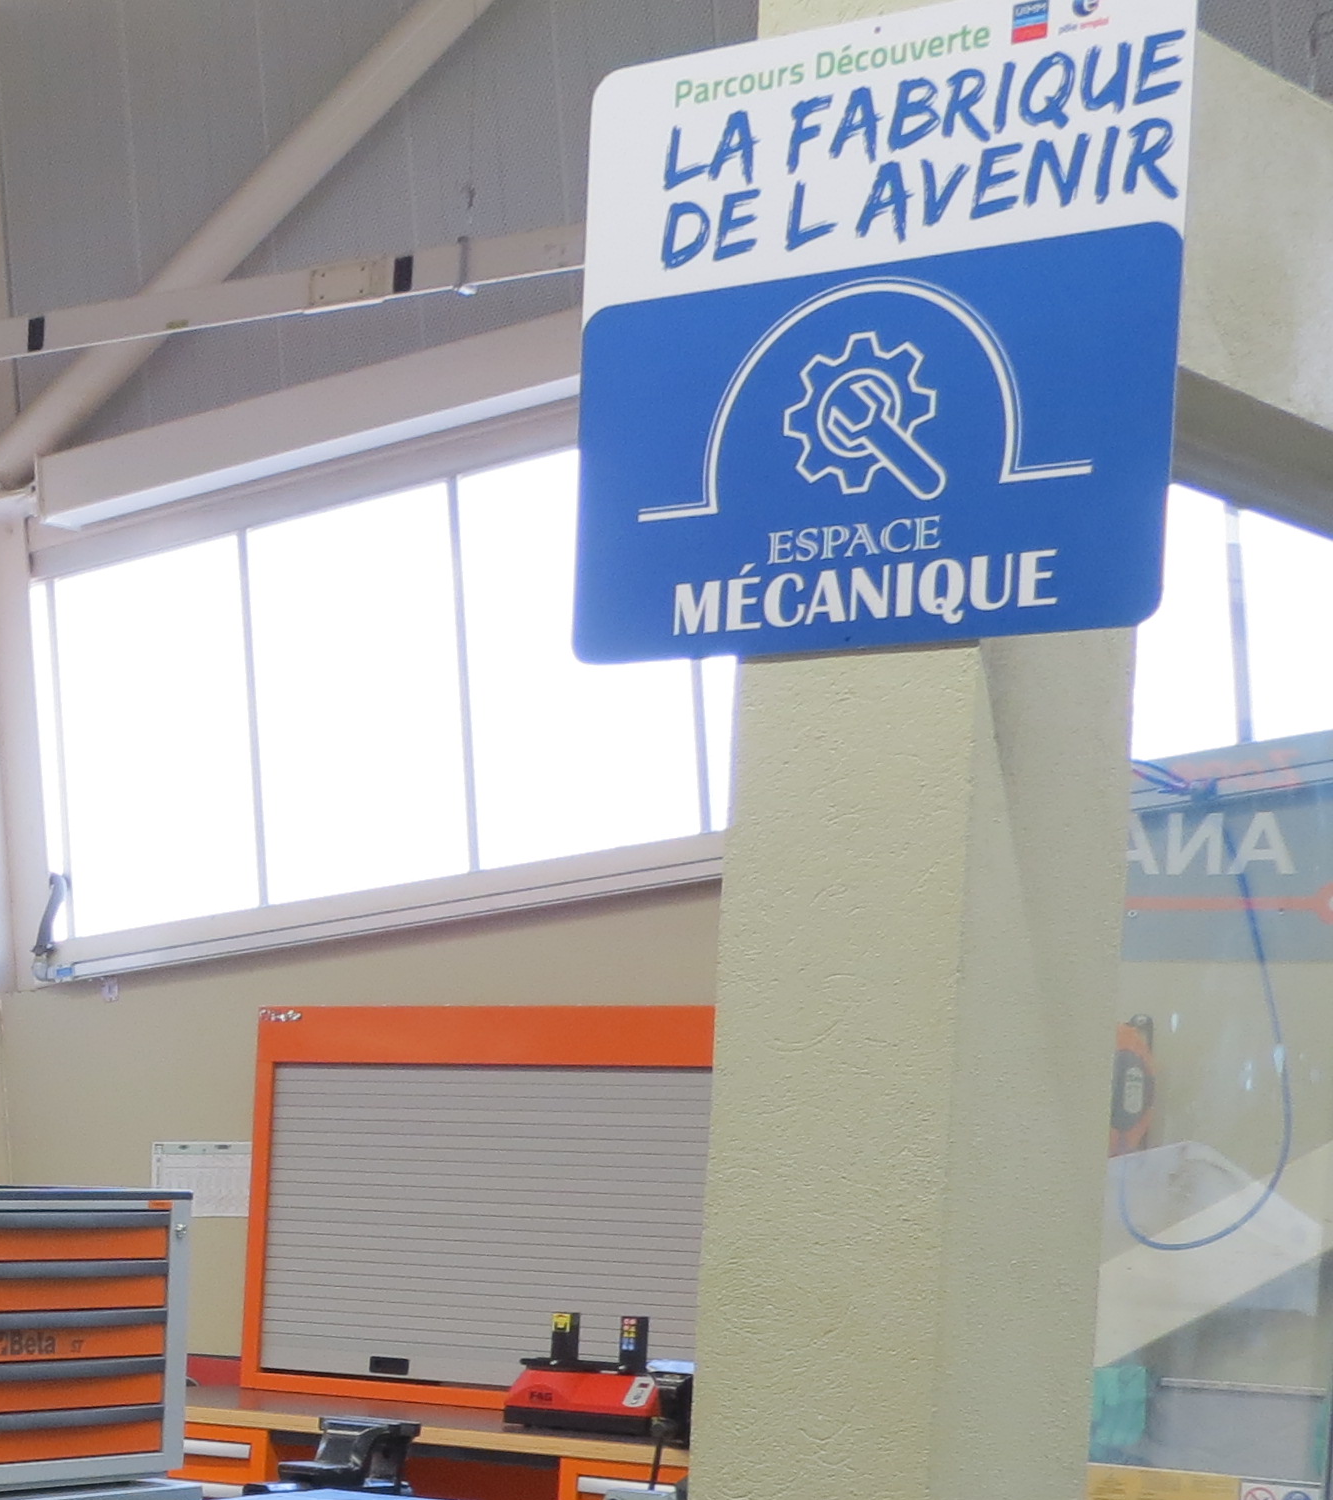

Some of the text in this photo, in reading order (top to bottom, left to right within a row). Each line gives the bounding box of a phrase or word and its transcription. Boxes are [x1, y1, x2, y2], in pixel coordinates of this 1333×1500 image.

[674, 22, 991, 108] Parcours Découverte
[663, 28, 1187, 191] LA FABRIQUE
[661, 187, 761, 270] DE
[766, 515, 942, 565] ESPACE
[672, 548, 1058, 636] MÉCANIQUE
[10, 1329, 56, 1355] Beta
[530, 1391, 553, 1402] FAG
